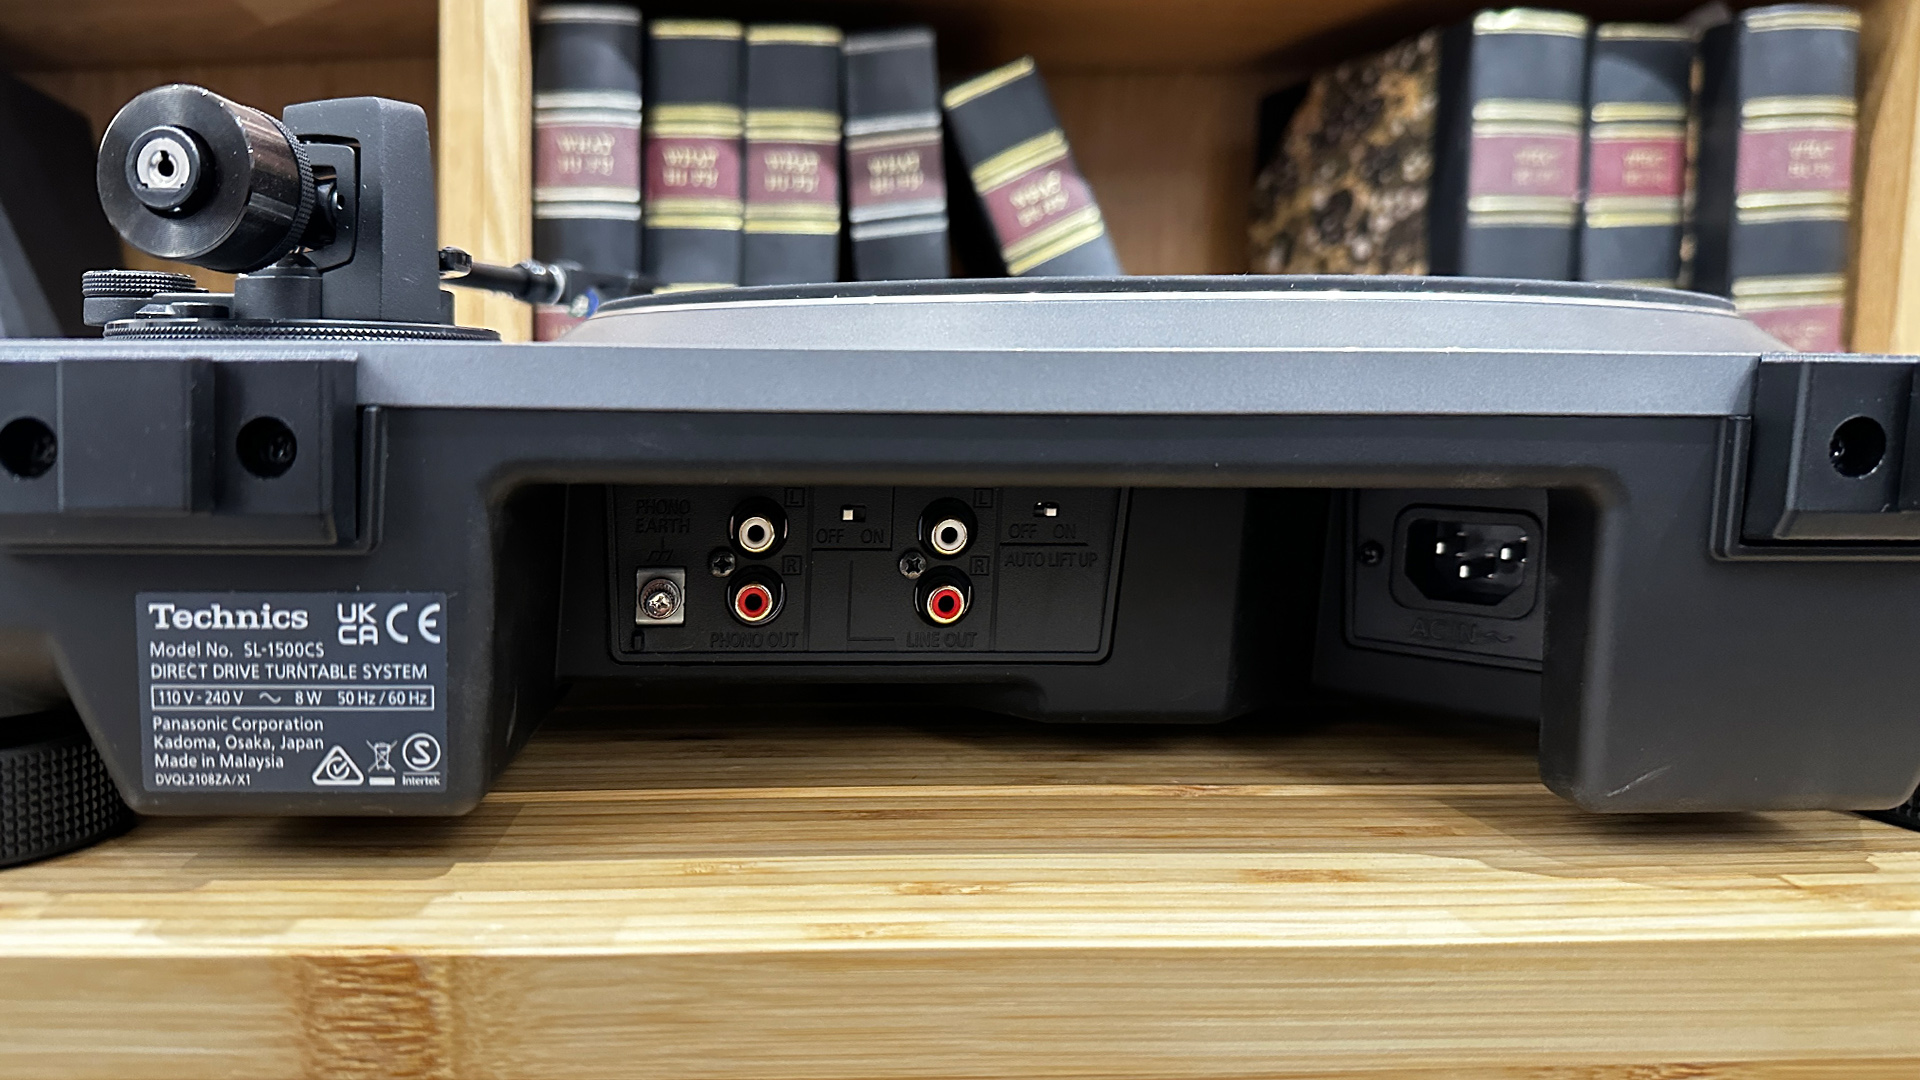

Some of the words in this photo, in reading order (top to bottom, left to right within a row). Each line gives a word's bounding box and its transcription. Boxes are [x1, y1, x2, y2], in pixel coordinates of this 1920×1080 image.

[636, 499, 691, 514] PHONO
[635, 518, 690, 533] EARTH
[1008, 524, 1037, 539] OFF
[1053, 524, 1077, 539] ON
[816, 528, 845, 543] OFF
[860, 529, 884, 543] ON
[1004, 552, 1047, 567] AUTO
[1050, 552, 1076, 567] LIFT
[1079, 552, 1098, 568] UP
[148, 602, 309, 629] Technics
[337, 602, 378, 623] UK
[386, 602, 441, 645] CE
[337, 624, 379, 645] CA
[710, 632, 764, 648] PHONO
[769, 632, 798, 648] OUT
[906, 632, 940, 648] LINE
[945, 632, 977, 648] OUT
[150, 640, 200, 658] Model
[206, 642, 234, 658] No.
[244, 641, 325, 658] SL-1500CS
[151, 663, 208, 680] DIRECT
[213, 663, 260, 680] DRIVE
[265, 663, 357, 680] TURNTABLE
[363, 663, 428, 680] SYSTEM
[153, 716, 228, 732] Panasonic
[232, 716, 324, 735] Corporation
[154, 735, 221, 752] Kadoma,
[225, 735, 276, 752] Osaka,
[279, 735, 324, 754] Japan
[155, 753, 198, 769] Made
[202, 753, 216, 769] in
[220, 753, 284, 773] Malaysia
[156, 773, 251, 787] DVQL2108ZA/X1
[402, 774, 441, 786] Intertek
